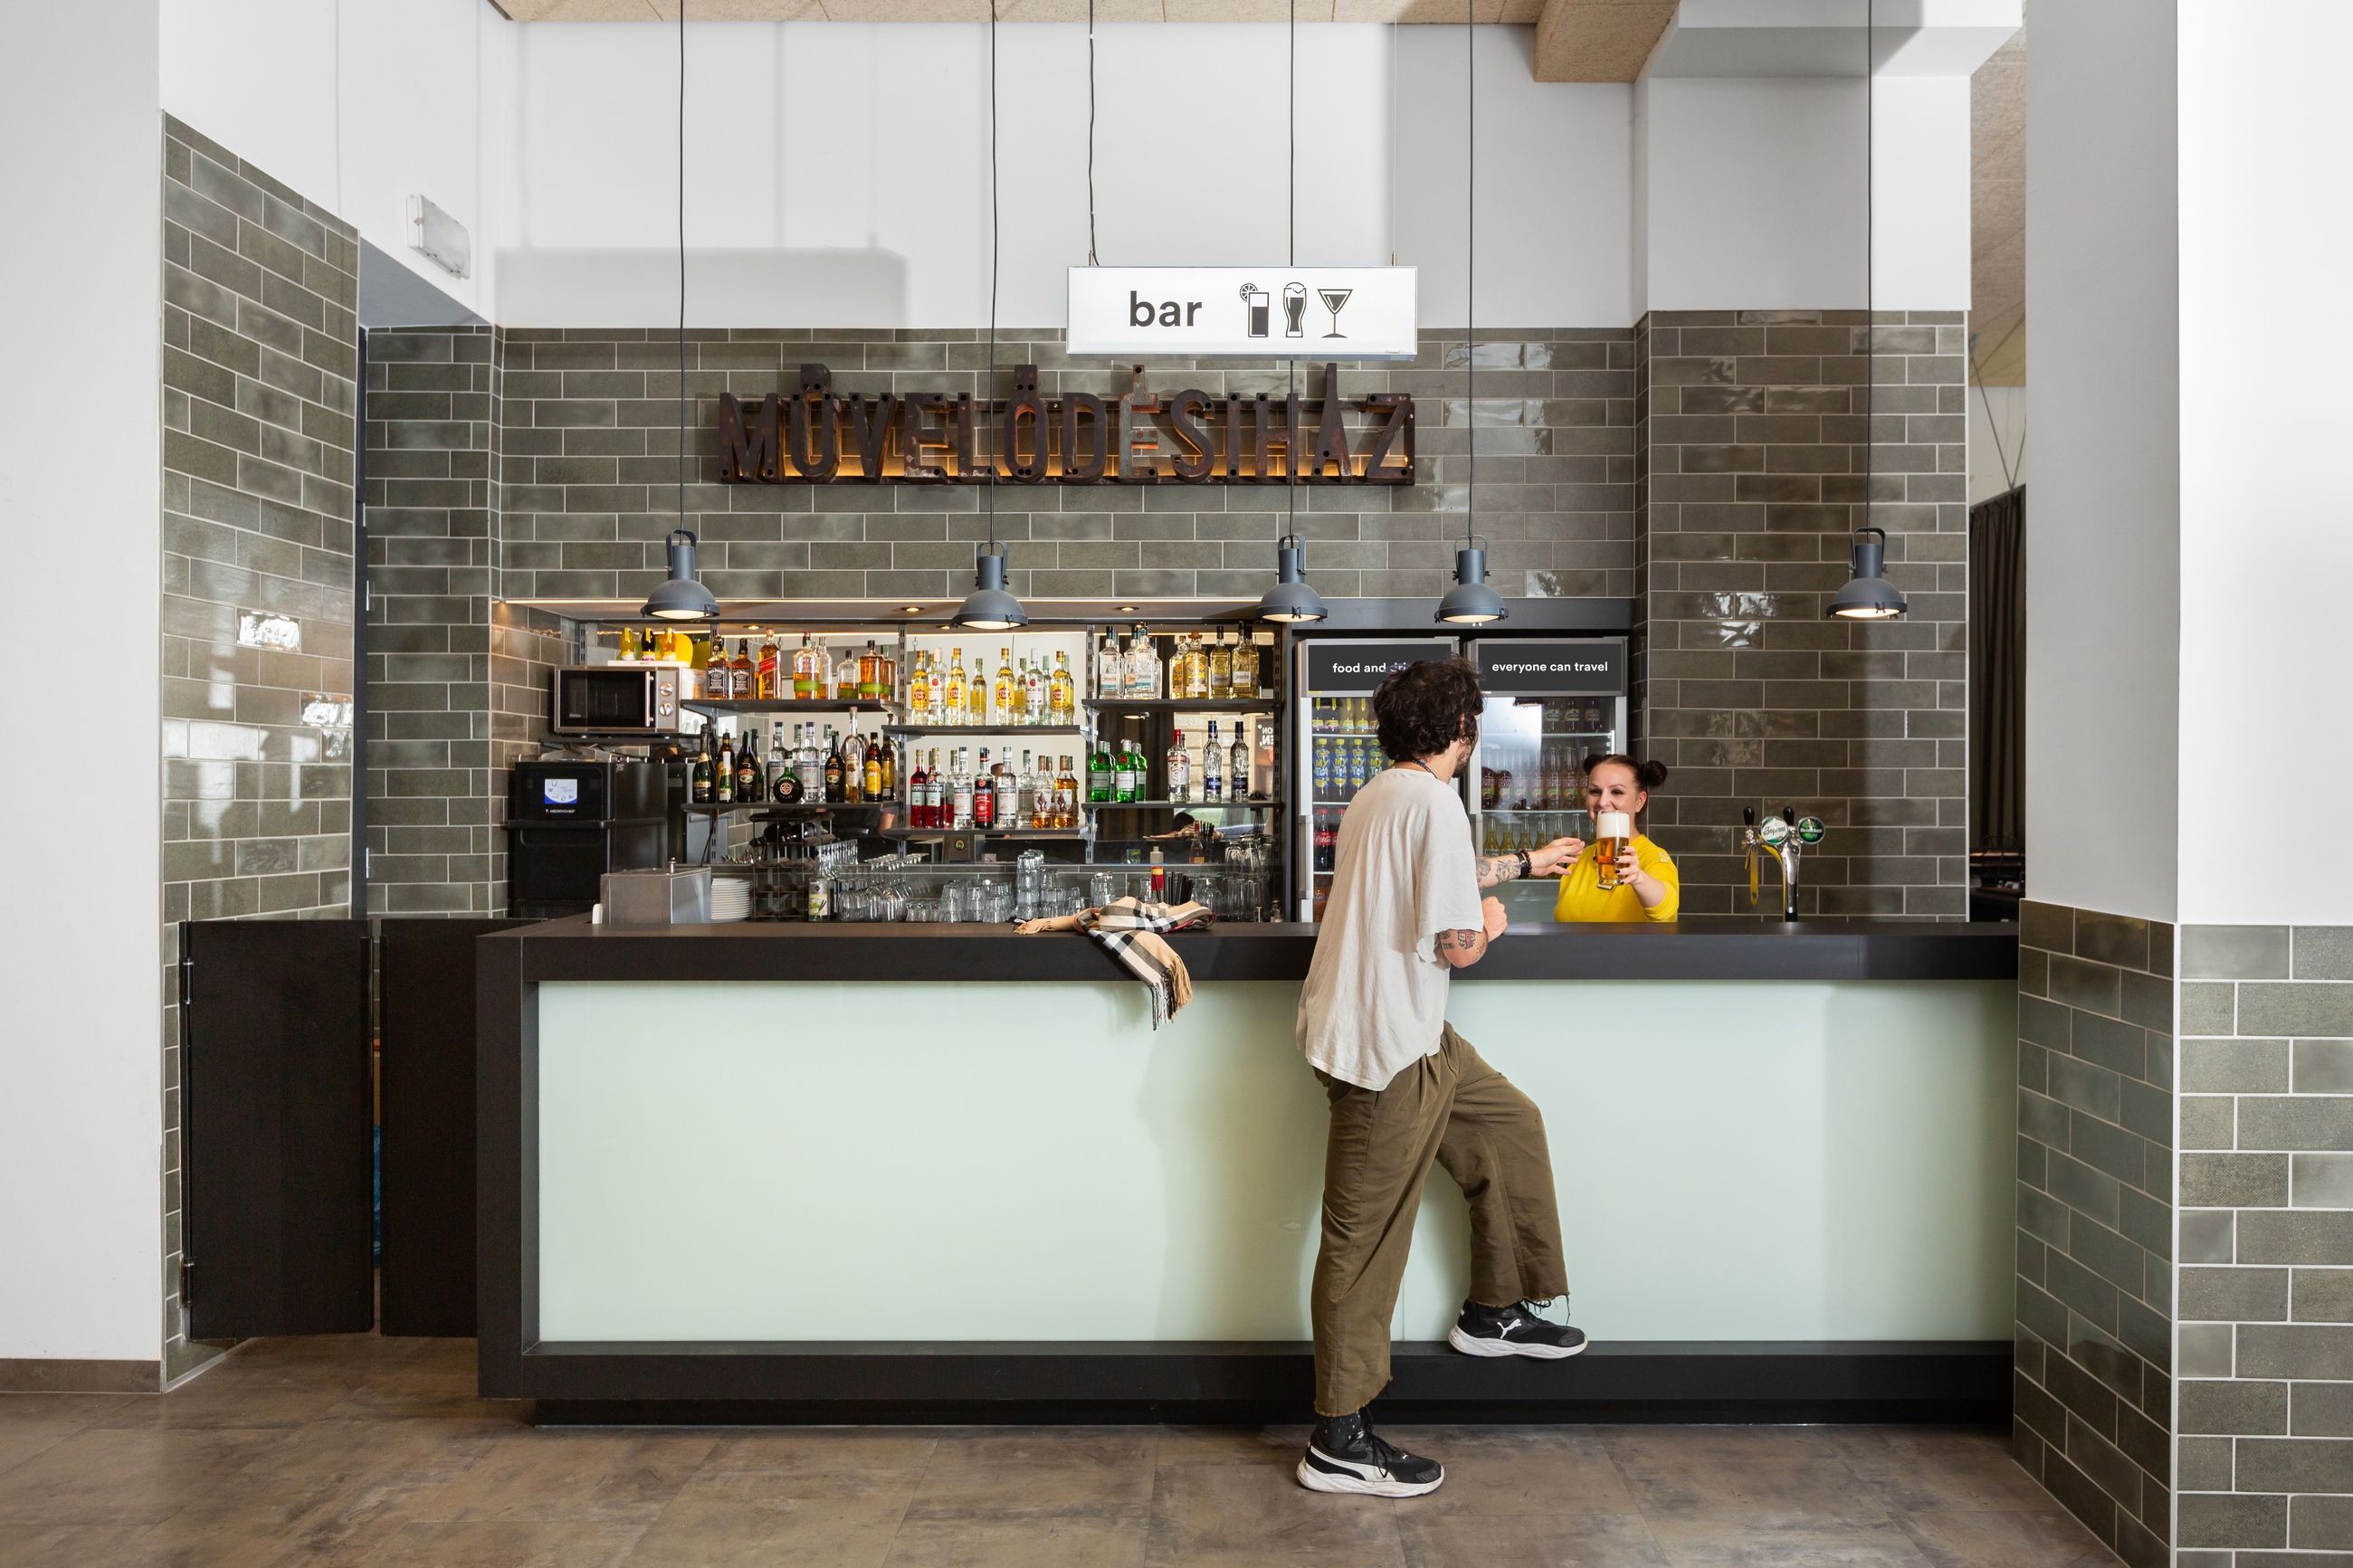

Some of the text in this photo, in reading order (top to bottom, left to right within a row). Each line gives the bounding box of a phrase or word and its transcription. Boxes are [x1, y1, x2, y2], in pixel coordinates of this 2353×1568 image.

[1129, 290, 1202, 327] bar
[1332, 662, 1360, 673] food
[1364, 662, 1386, 673] and
[1491, 661, 1608, 674] everyone can travel
[1316, 758, 1328, 767] MY
[1335, 758, 1347, 767] MY
[1352, 758, 1365, 767] MY
[1315, 766, 1328, 776] TEA
[1334, 766, 1347, 775] TEA
[1352, 766, 1365, 775] TEA
